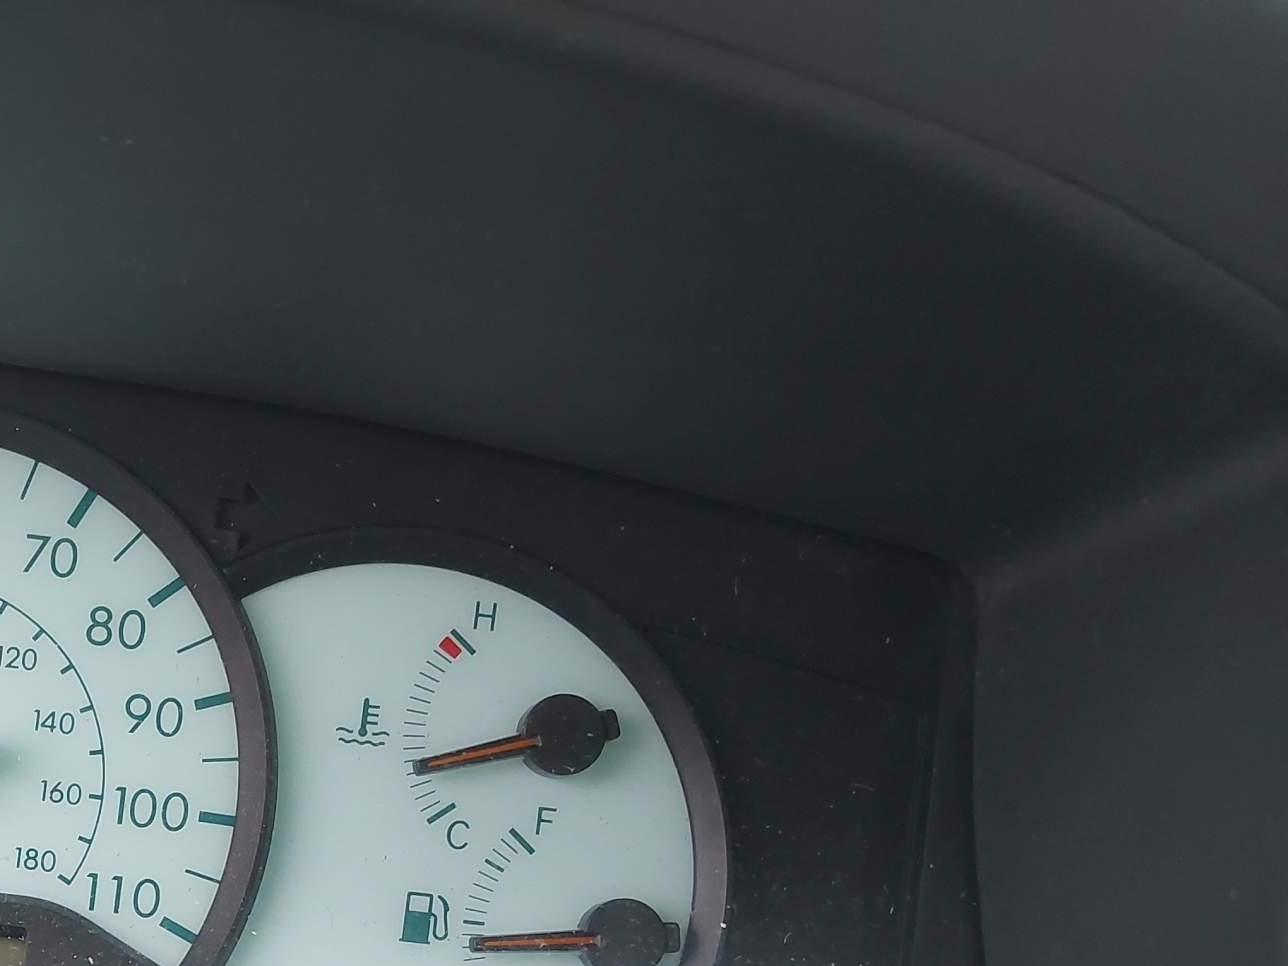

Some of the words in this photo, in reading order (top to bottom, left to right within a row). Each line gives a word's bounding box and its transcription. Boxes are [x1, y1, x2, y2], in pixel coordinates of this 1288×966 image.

[22, 533, 79, 578] 70
[86, 607, 147, 650] 80
[474, 600, 498, 632] H
[33, 708, 75, 736] 140
[125, 693, 184, 738] 90
[40, 778, 82, 806] 160
[113, 786, 190, 833] 100
[536, 806, 558, 835] F
[446, 820, 471, 851] C
[14, 846, 57, 874] 180
[87, 872, 161, 919] 110
